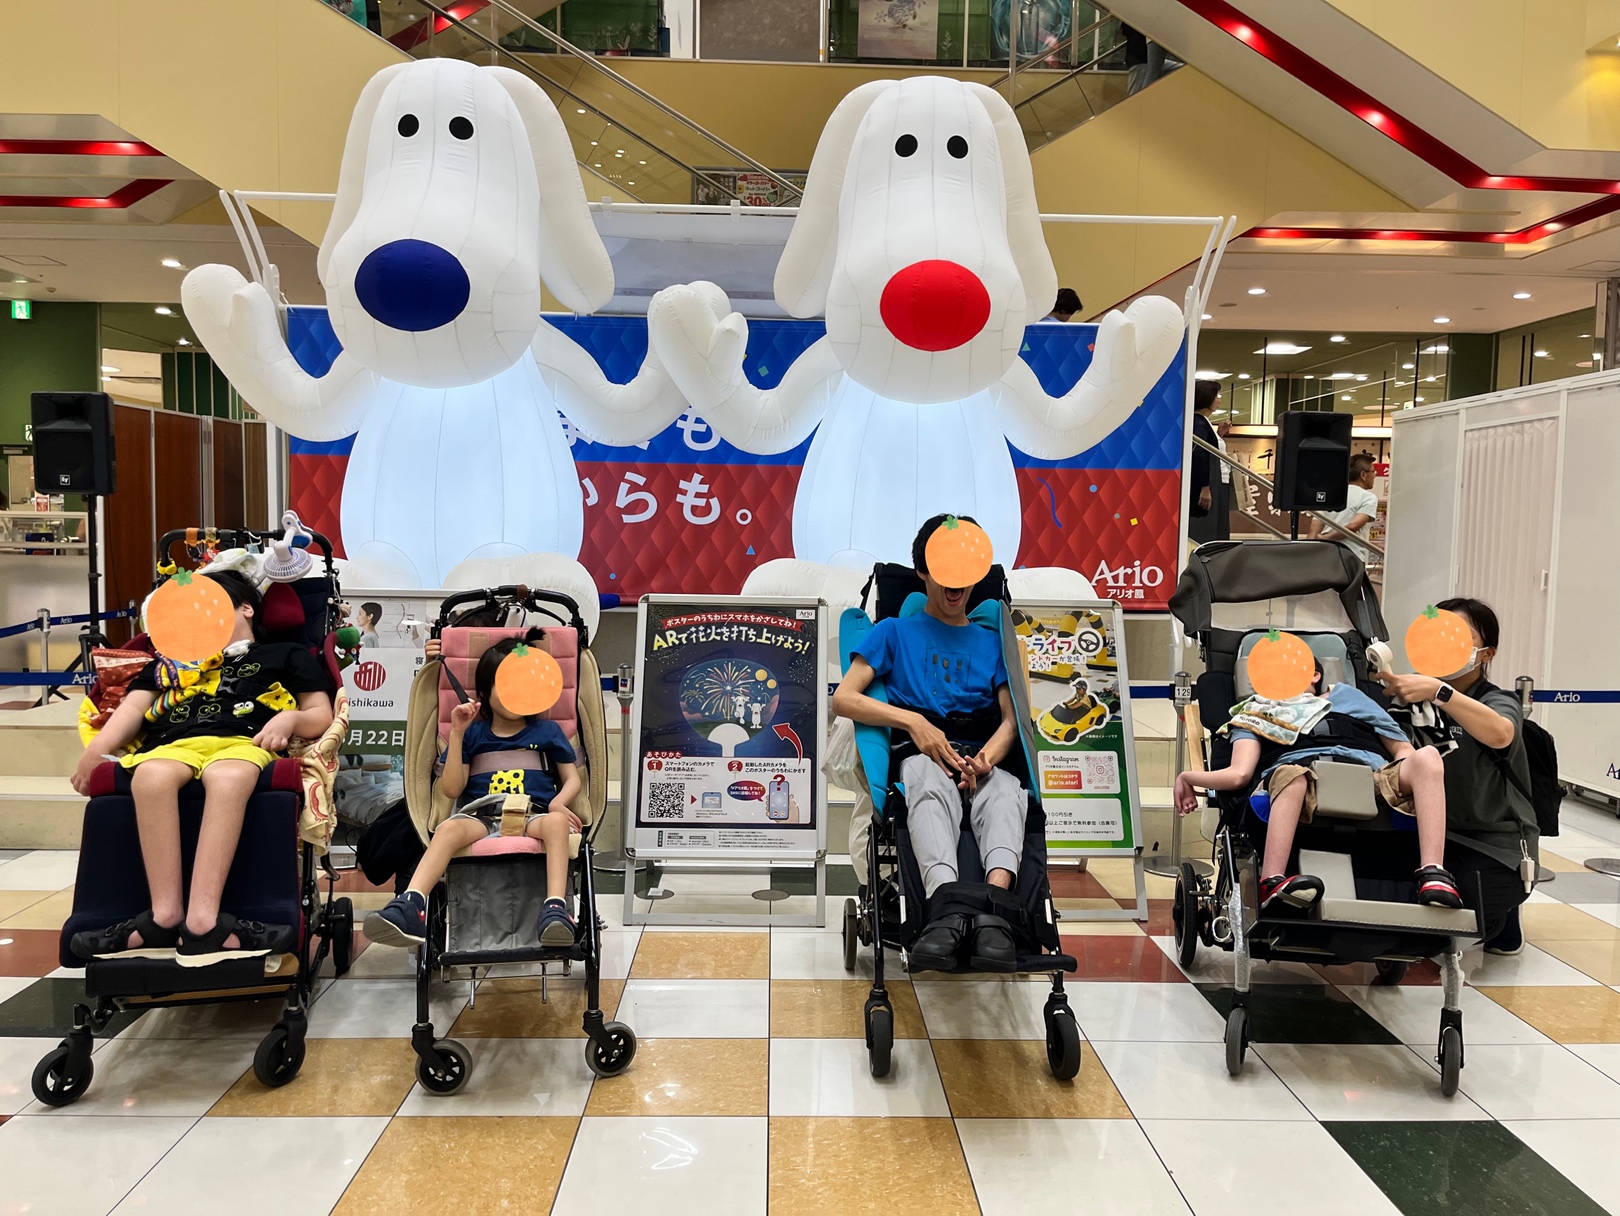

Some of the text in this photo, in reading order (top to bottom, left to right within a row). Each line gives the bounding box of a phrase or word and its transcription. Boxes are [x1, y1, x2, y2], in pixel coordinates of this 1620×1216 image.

[1090, 559, 1164, 587] Ario
[1554, 691, 1581, 702] Ario
[348, 698, 394, 708] ishikawa
[342, 729, 405, 747] 月22日
[1052, 756, 1079, 764] Instagram
